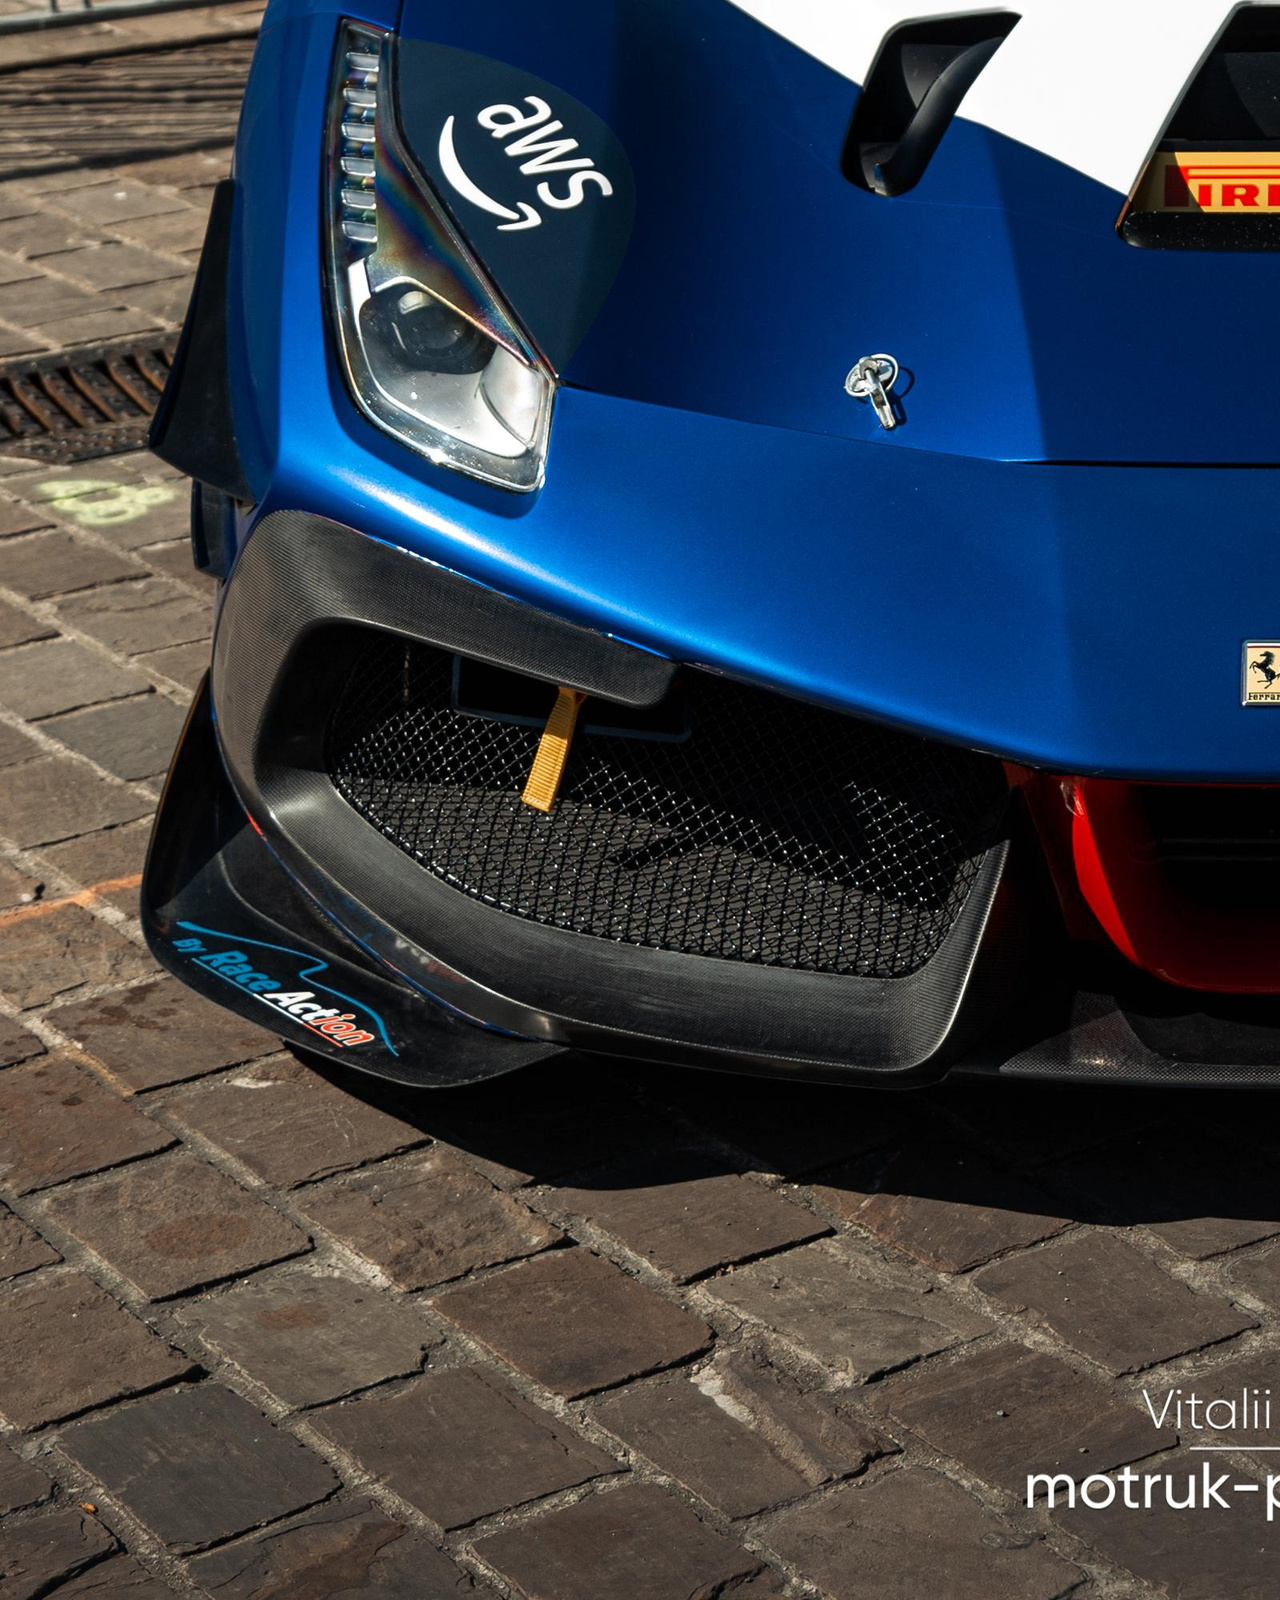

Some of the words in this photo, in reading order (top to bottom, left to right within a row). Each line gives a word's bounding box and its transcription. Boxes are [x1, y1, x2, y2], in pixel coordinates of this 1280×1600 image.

[477, 95, 613, 209] aws
[173, 937, 207, 953] By
[198, 950, 283, 992] Race
[264, 991, 376, 1047] Action
